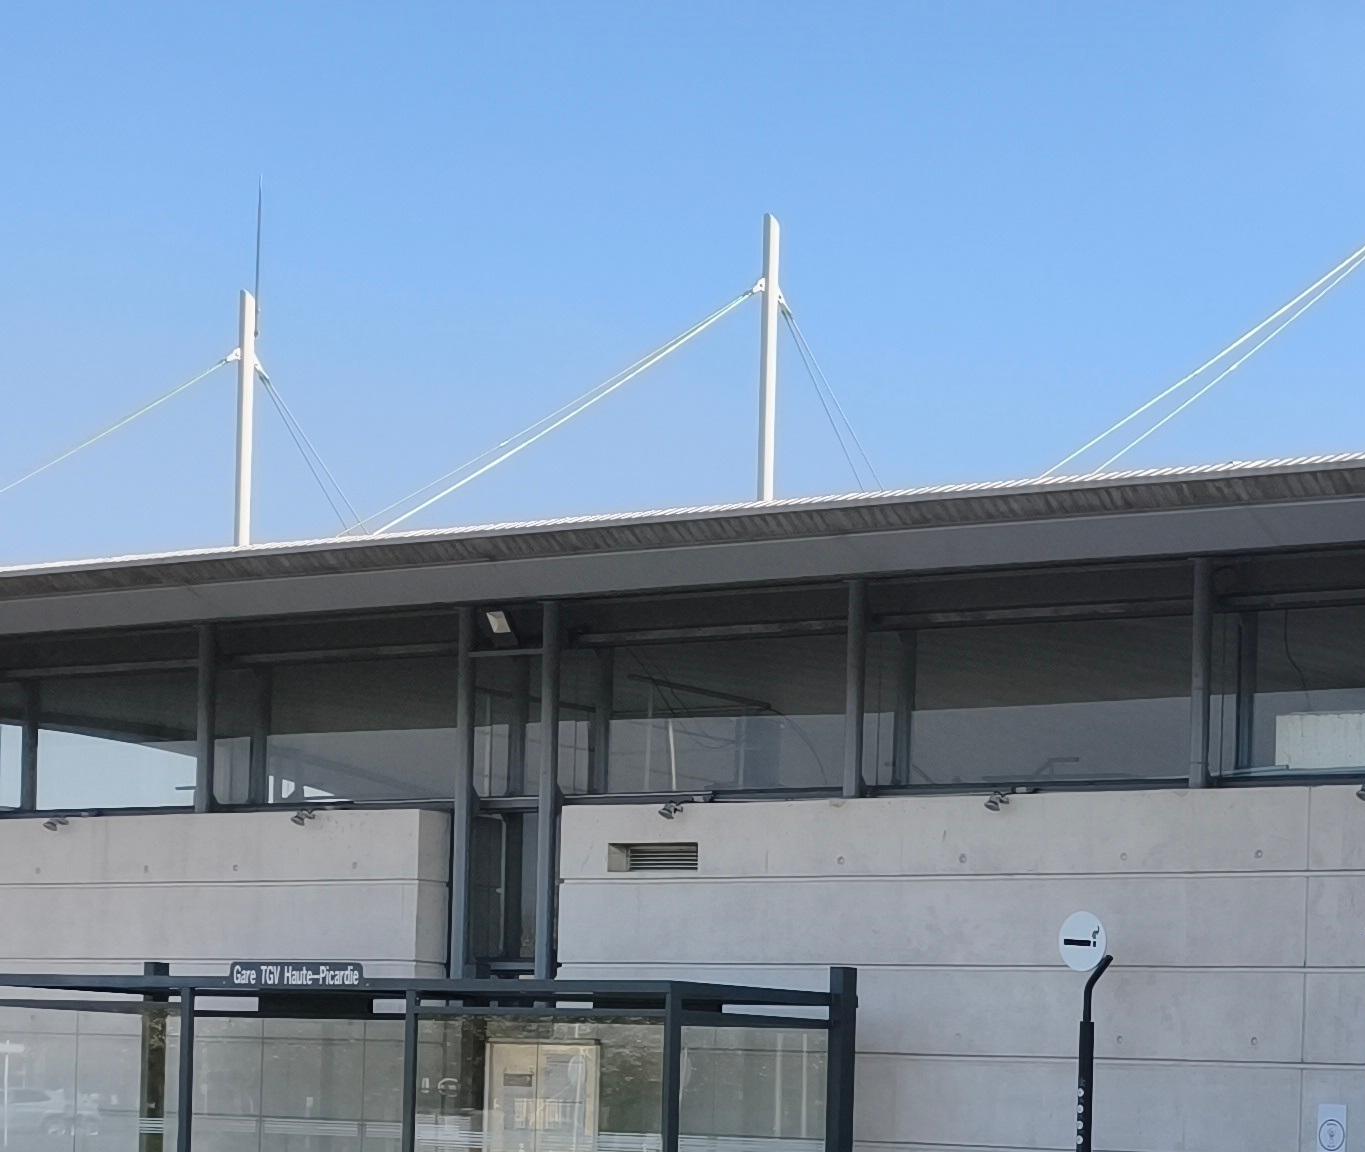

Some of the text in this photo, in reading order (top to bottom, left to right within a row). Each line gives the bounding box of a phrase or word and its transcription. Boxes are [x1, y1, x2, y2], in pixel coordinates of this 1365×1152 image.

[233, 965, 360, 985] Gare TGV Haute-Picardie
